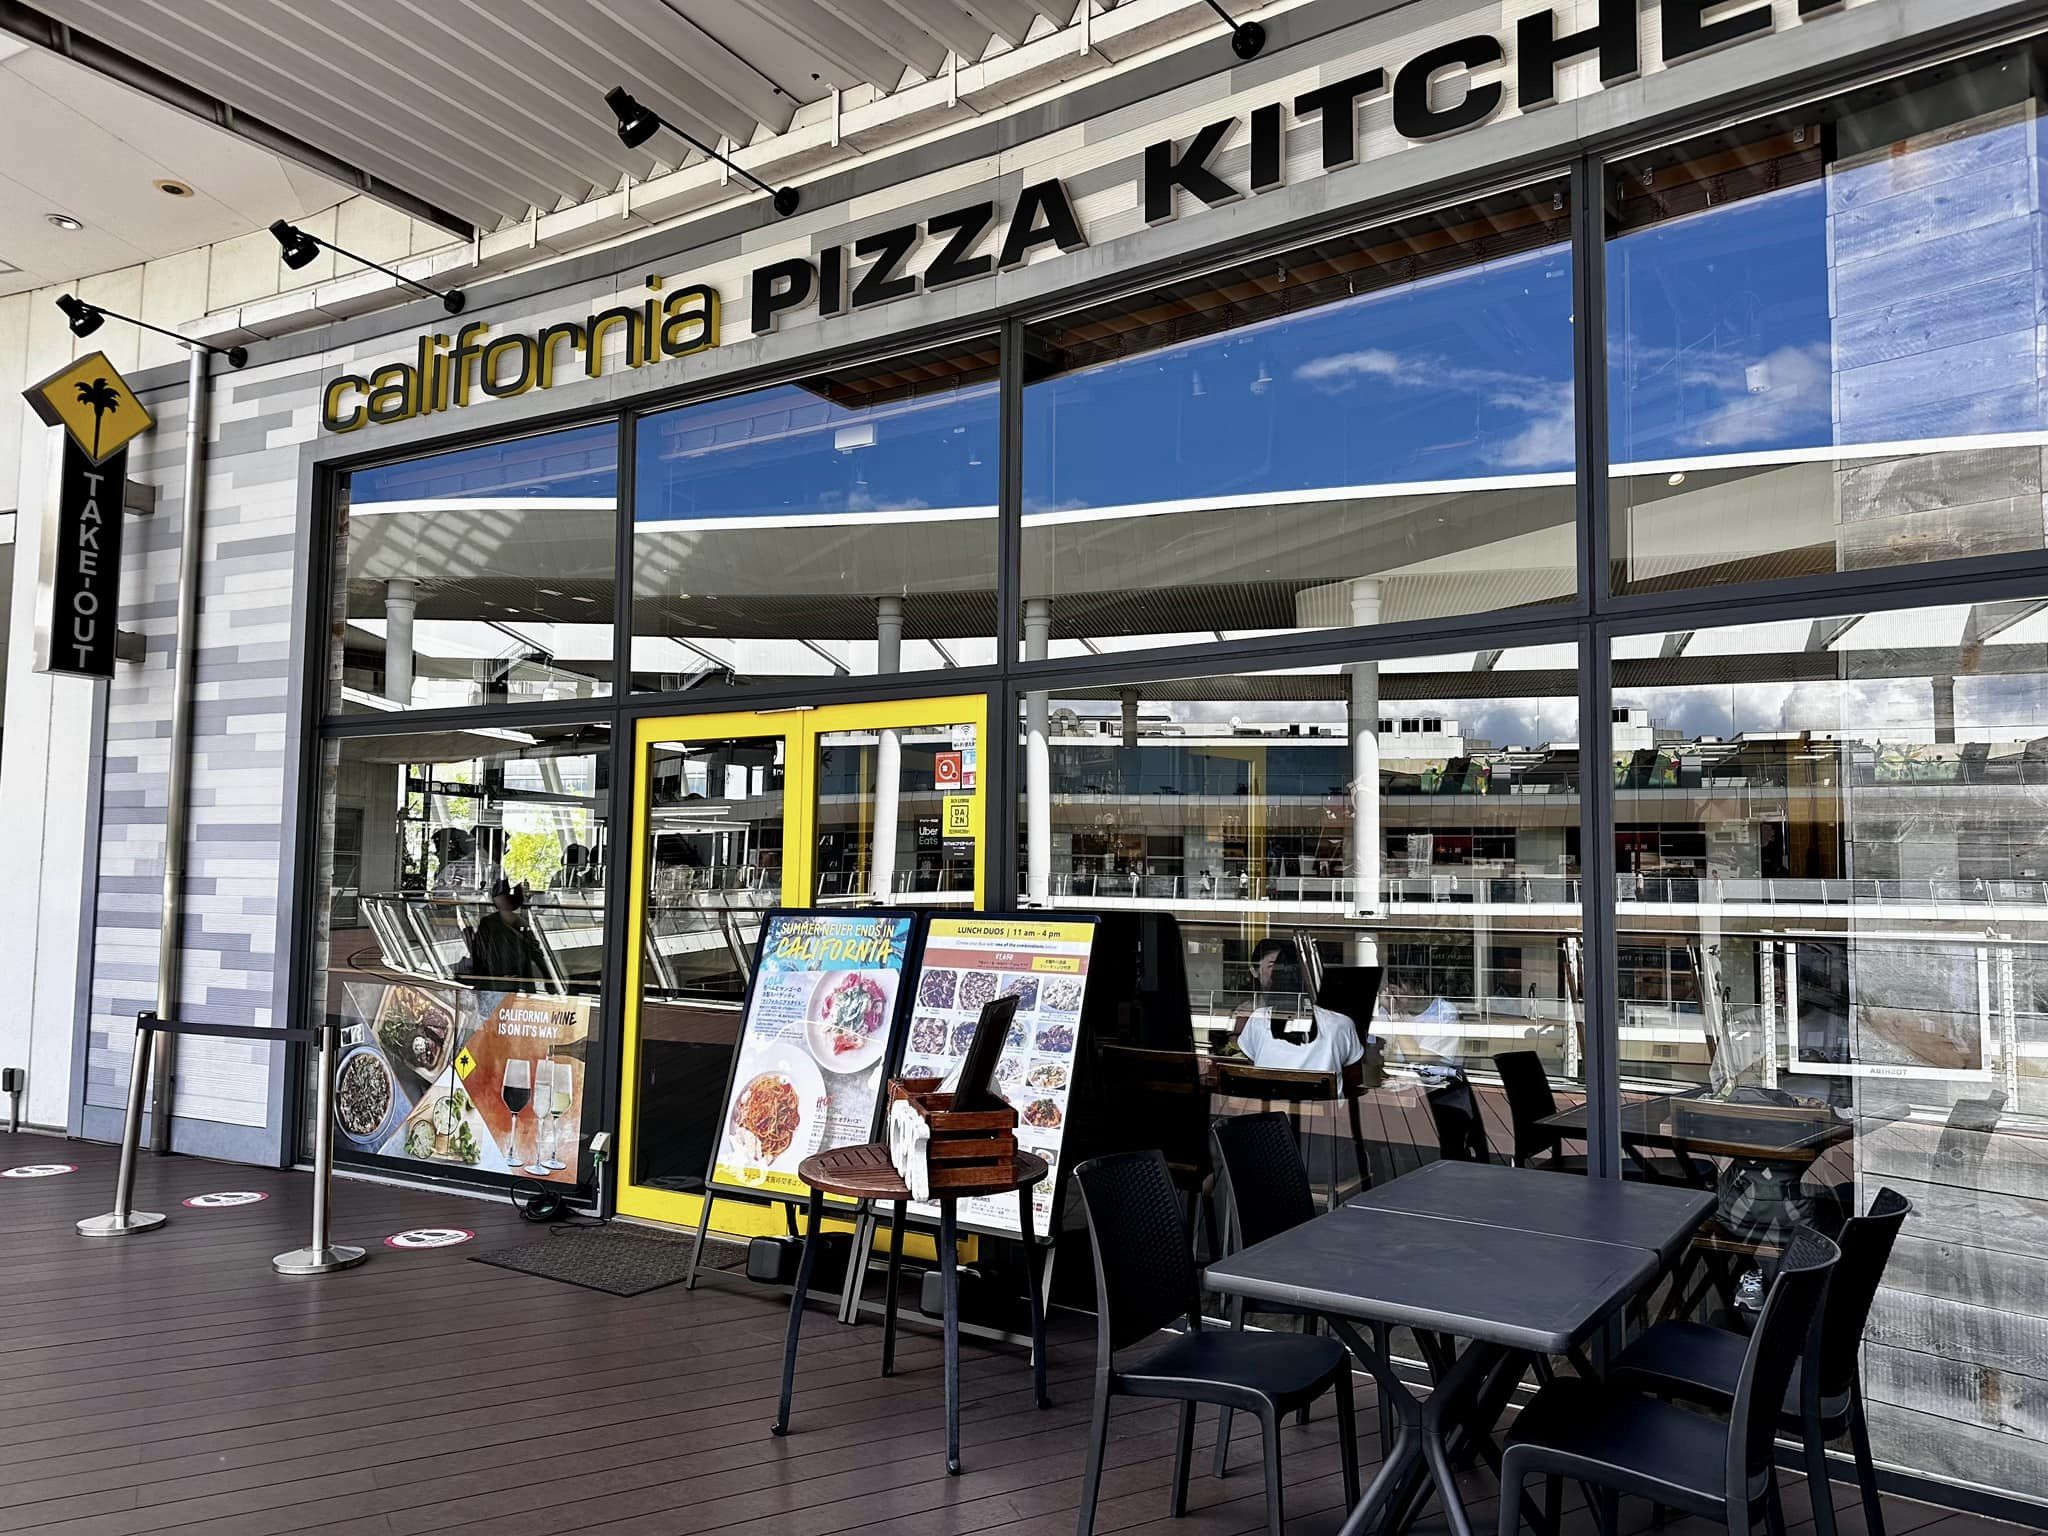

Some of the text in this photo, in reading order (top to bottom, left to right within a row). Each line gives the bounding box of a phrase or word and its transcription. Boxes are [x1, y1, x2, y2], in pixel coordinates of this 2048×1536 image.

[322, 0, 1847, 434] california PIZZA KITCHE
[72, 471, 105, 669] TAKE-OUT
[919, 826, 938, 836] Uber
[919, 836, 938, 845] Eats
[780, 922, 895, 938] SUMMER NEVER ENDS IN
[957, 926, 982, 935] LUNCH
[983, 927, 1005, 936] DUOS
[1013, 928, 1022, 936] 11
[1041, 929, 1047, 937] 4
[1048, 931, 1061, 940] pm
[776, 937, 893, 964] CALIFORNIA
[499, 1008, 577, 1026] CALIFORNIA WINE
[498, 1023, 559, 1039] IS ON IT'S WAY
